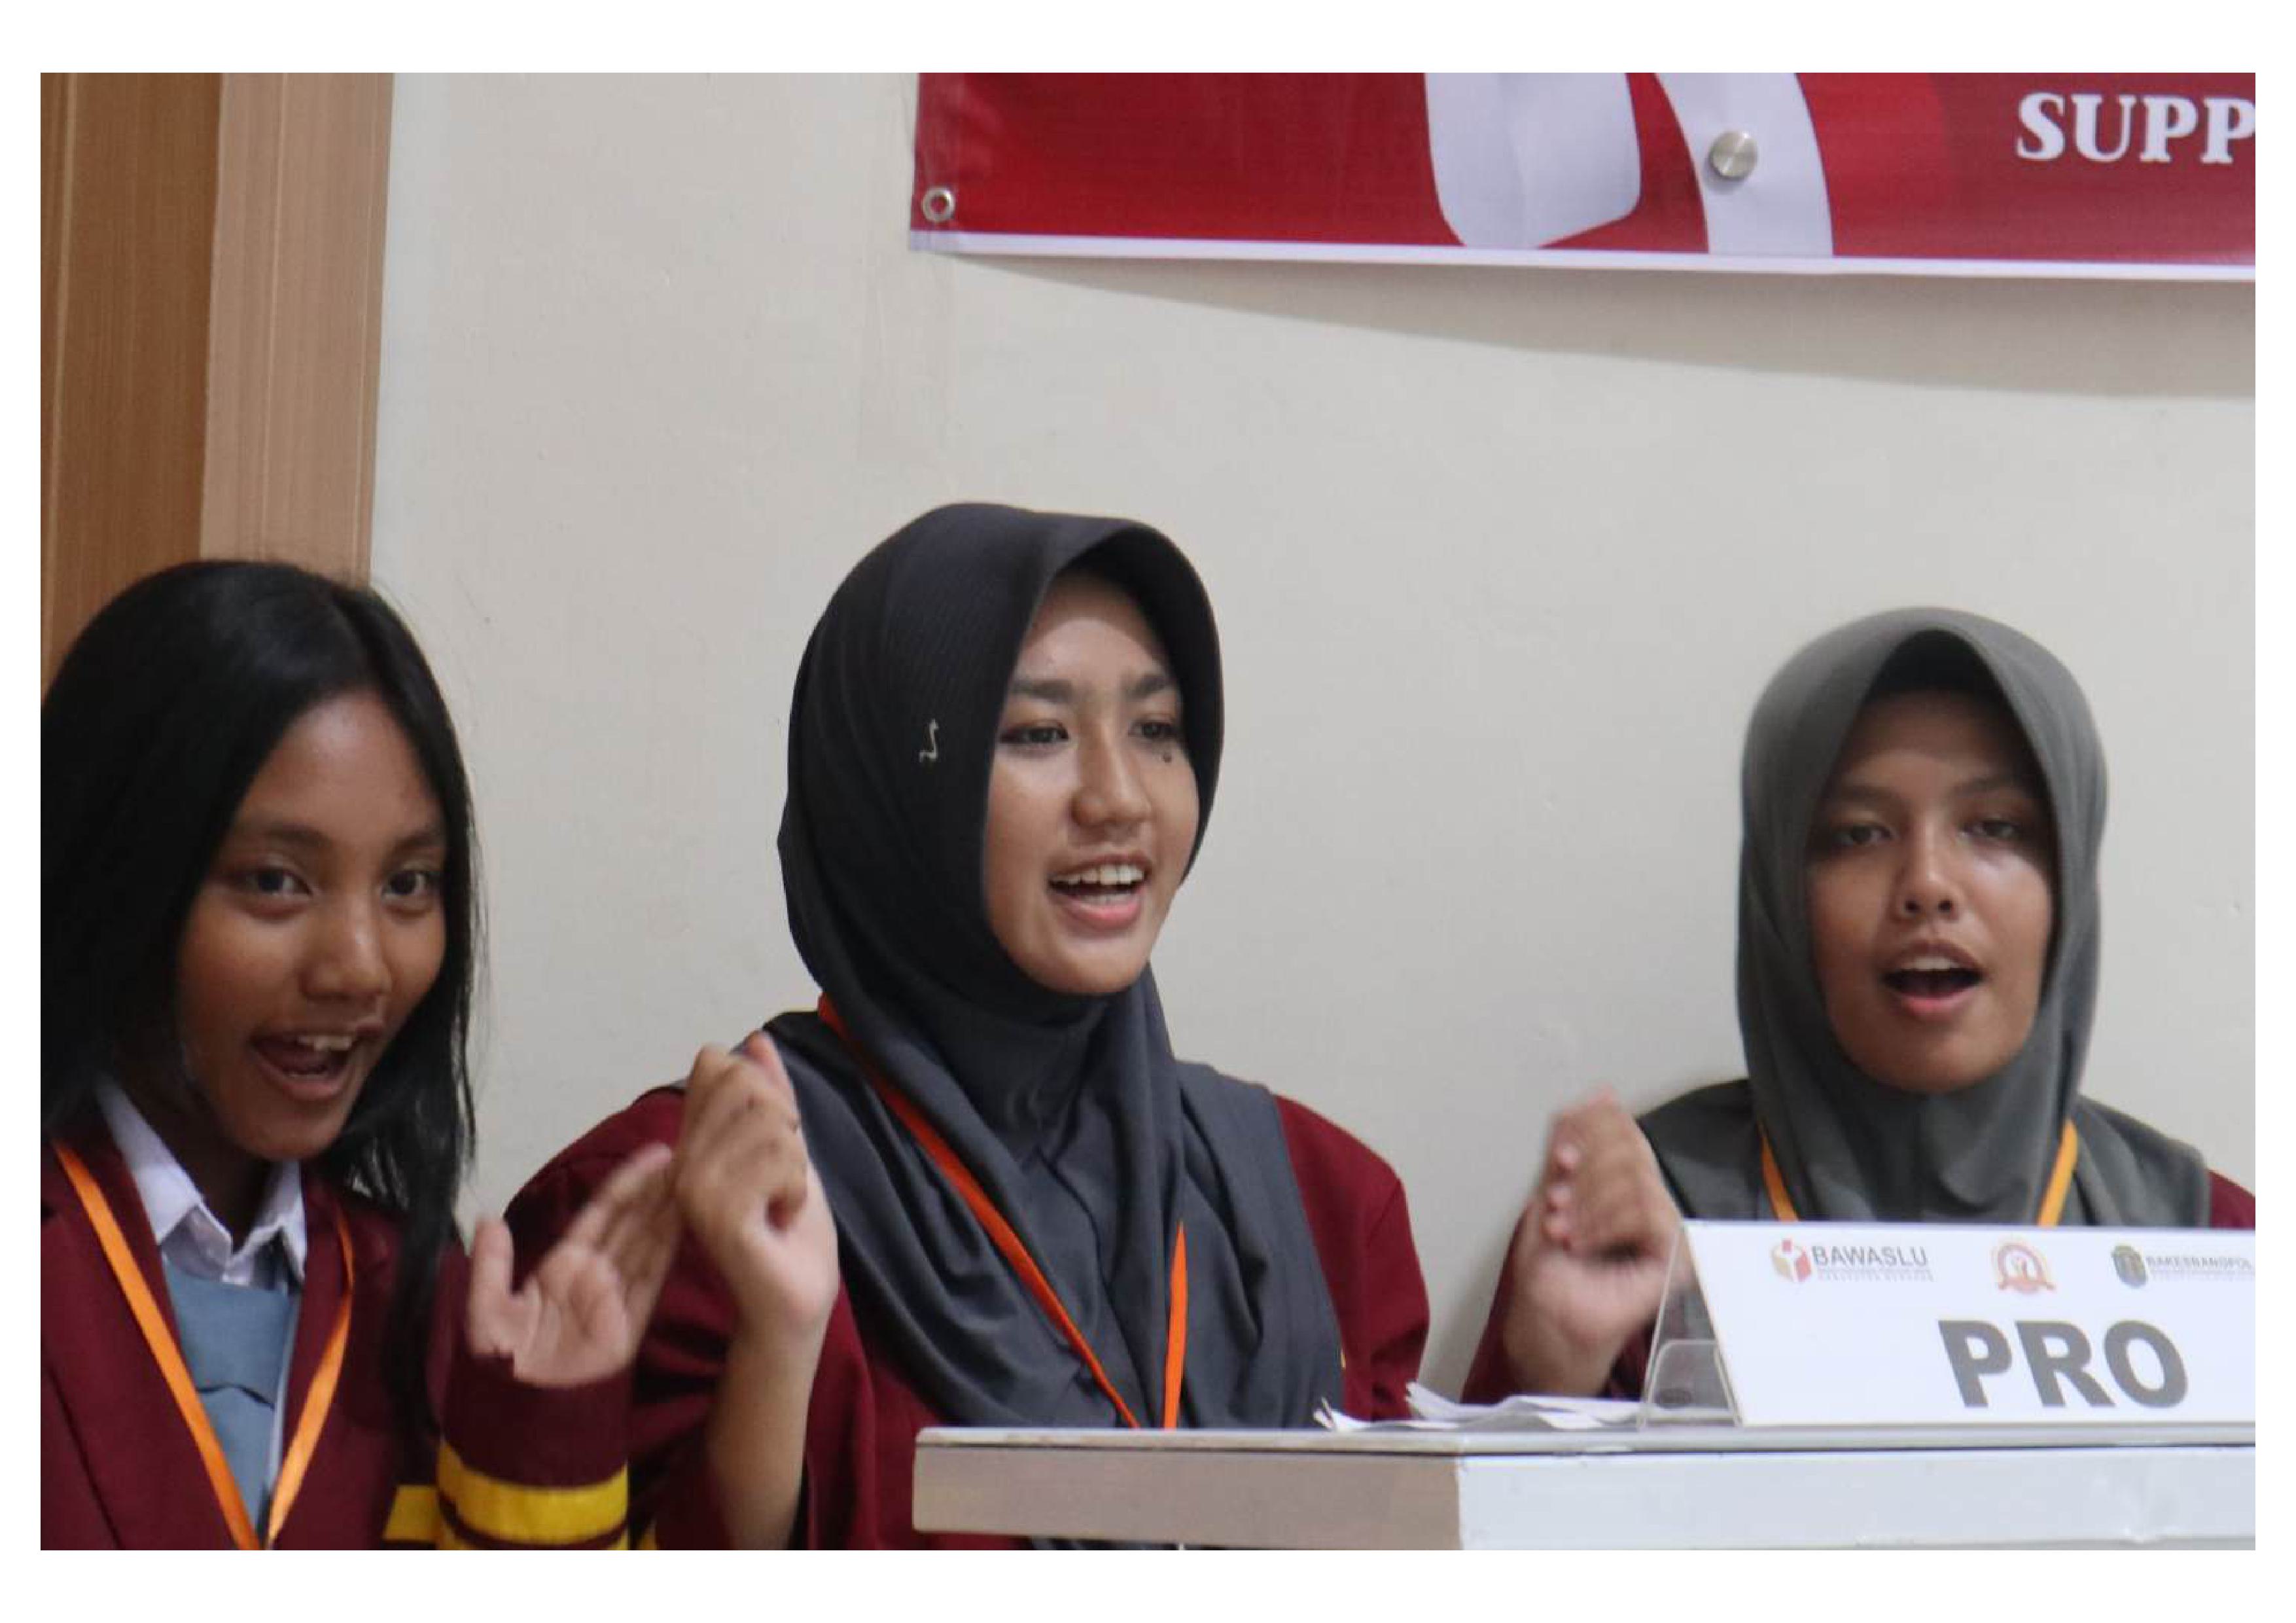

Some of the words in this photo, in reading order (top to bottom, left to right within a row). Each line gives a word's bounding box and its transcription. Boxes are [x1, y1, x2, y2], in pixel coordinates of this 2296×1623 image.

[2017, 92, 2255, 164] SUPP
[1811, 1245, 1929, 1266] BAWASLU
[1937, 1319, 2189, 1409] PRO
